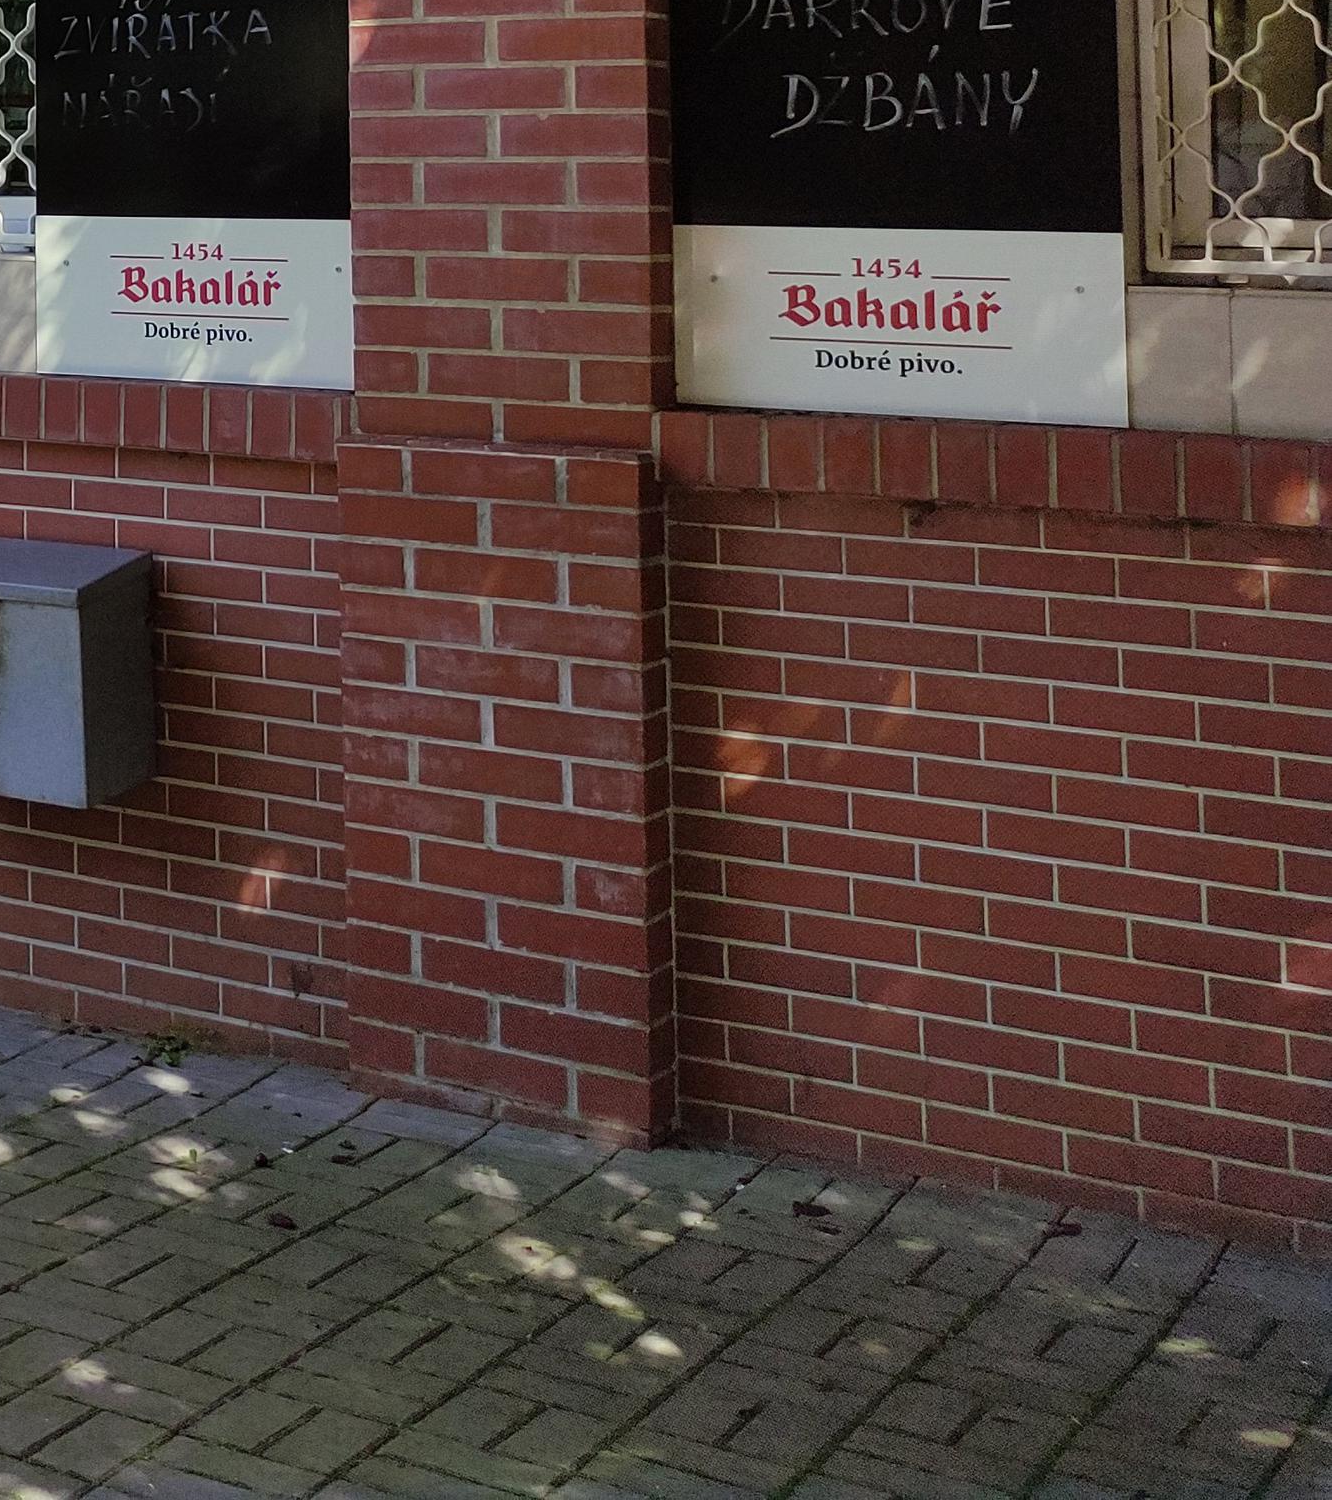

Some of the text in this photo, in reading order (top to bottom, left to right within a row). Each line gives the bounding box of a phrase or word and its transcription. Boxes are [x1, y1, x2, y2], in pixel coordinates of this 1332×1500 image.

[171, 243, 224, 261] 1454
[850, 258, 923, 279] 1454
[117, 265, 282, 307] Bakalář
[778, 284, 1002, 334] Bakalář
[144, 321, 253, 345] Dobré pivo.
[815, 349, 964, 378] Dobré pivo.
